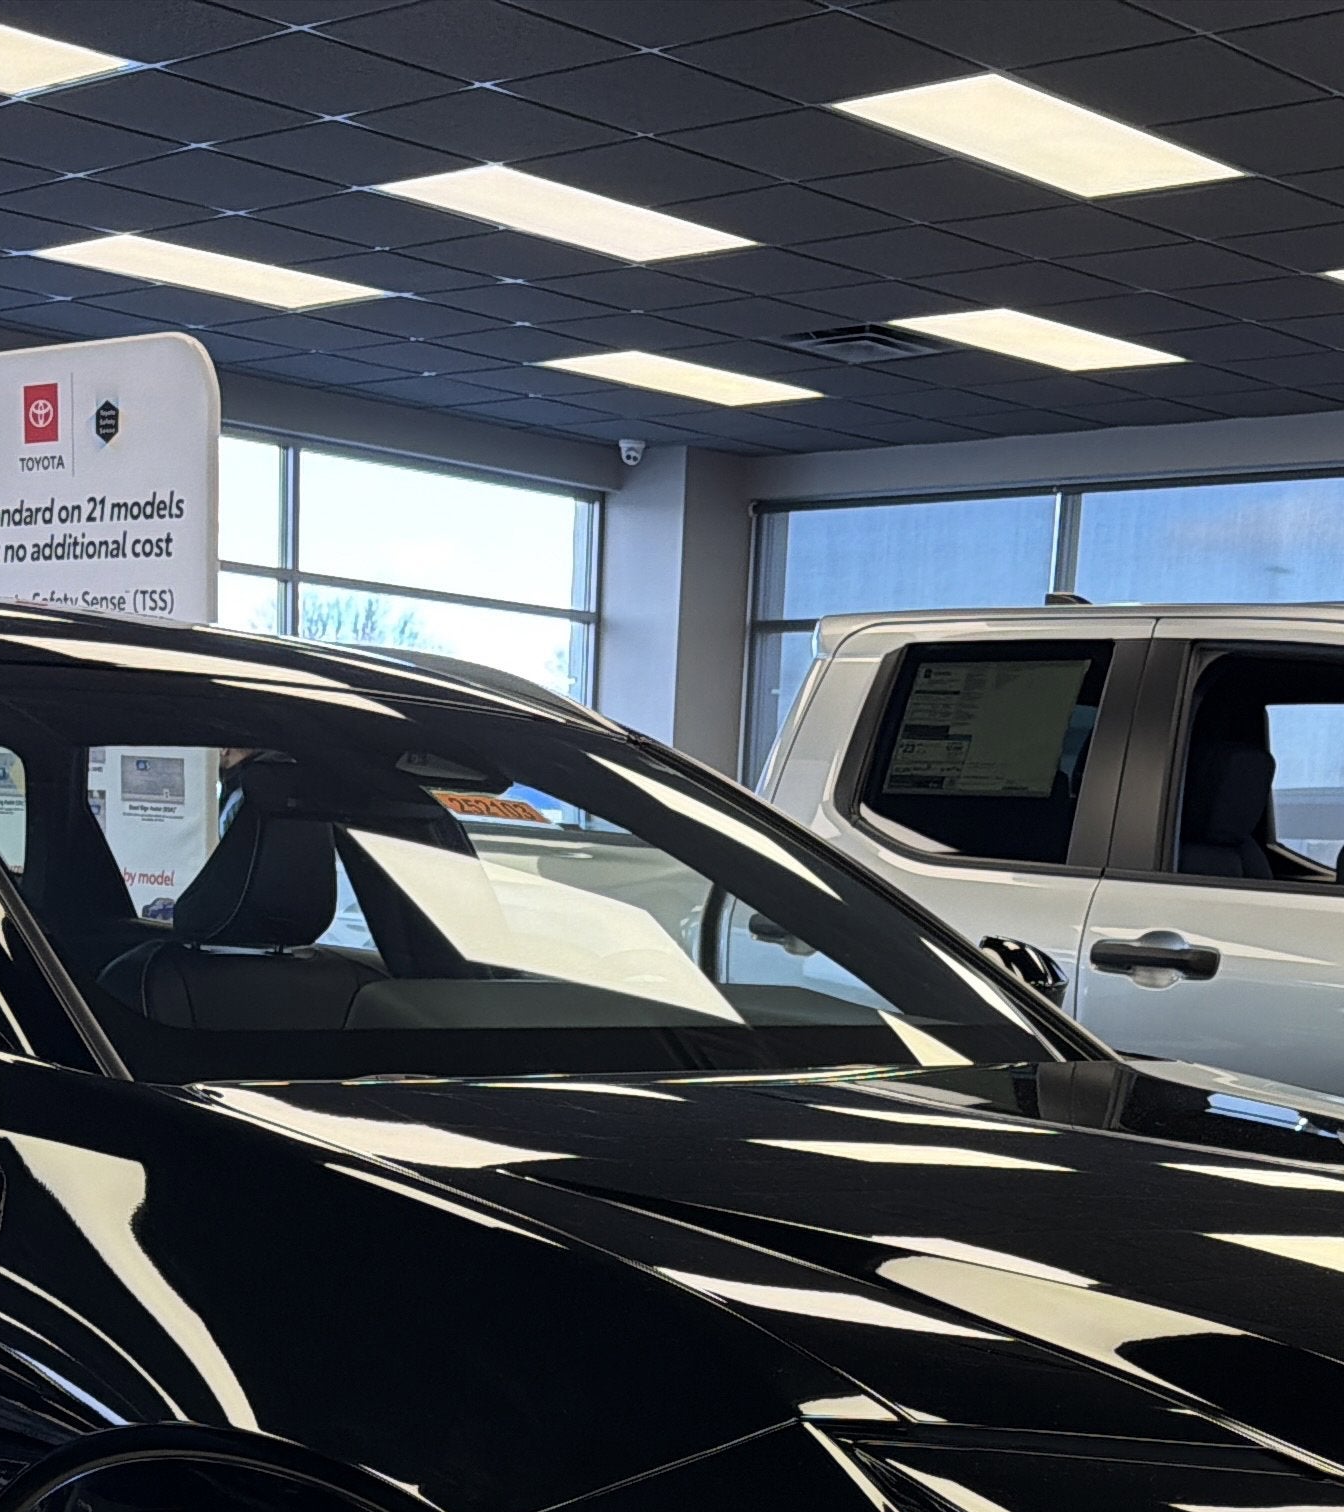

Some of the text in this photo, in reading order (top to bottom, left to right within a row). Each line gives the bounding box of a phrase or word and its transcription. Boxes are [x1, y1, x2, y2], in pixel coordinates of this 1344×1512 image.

[19, 455, 65, 472] TOYOTA
[58, 503, 82, 524] on
[86, 496, 106, 523] 21
[110, 490, 185, 521] models
[4, 544, 27, 563] no
[31, 530, 128, 561] additional
[132, 532, 173, 558] cost
[133, 588, 175, 614] (TSS)
[123, 867, 175, 886] by model
